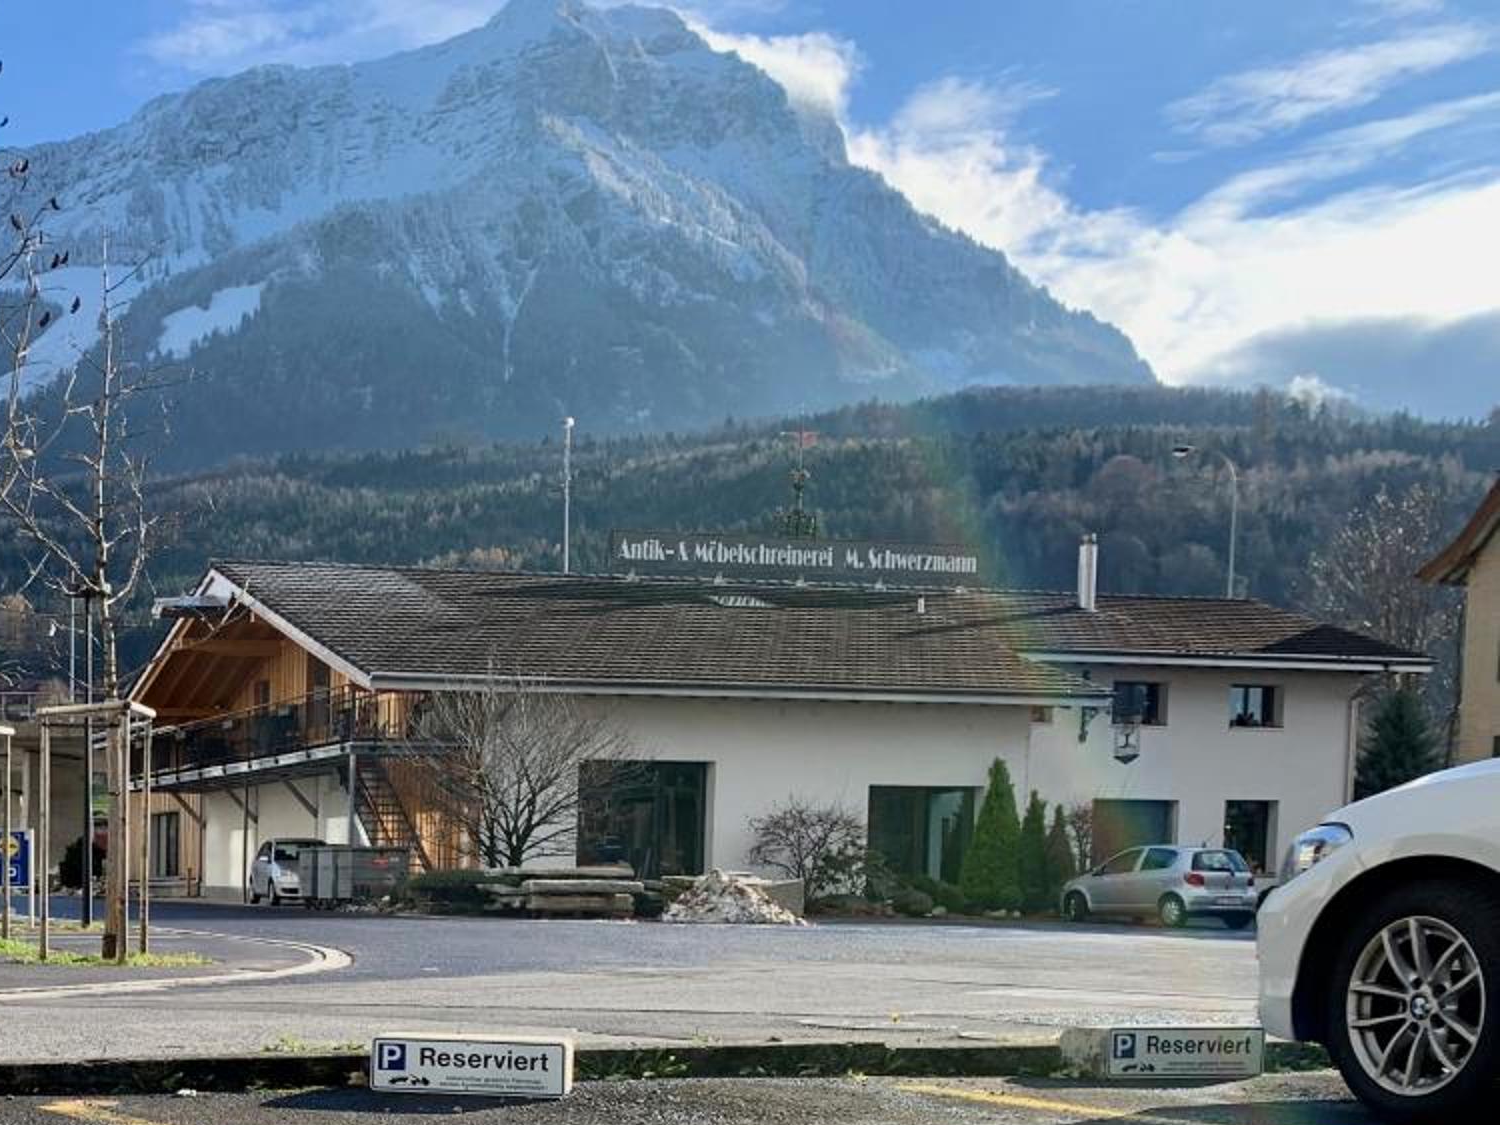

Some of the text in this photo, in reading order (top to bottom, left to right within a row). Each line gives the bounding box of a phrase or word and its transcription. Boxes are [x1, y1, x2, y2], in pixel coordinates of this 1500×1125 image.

[618, 537, 674, 561] Antik-
[694, 540, 833, 567] Möbelschreinerei
[844, 548, 865, 569] M.
[868, 547, 978, 573] Schwerzmann
[381, 1044, 549, 1072] P Reserviert
[1115, 1035, 1251, 1057] P Reserviert
